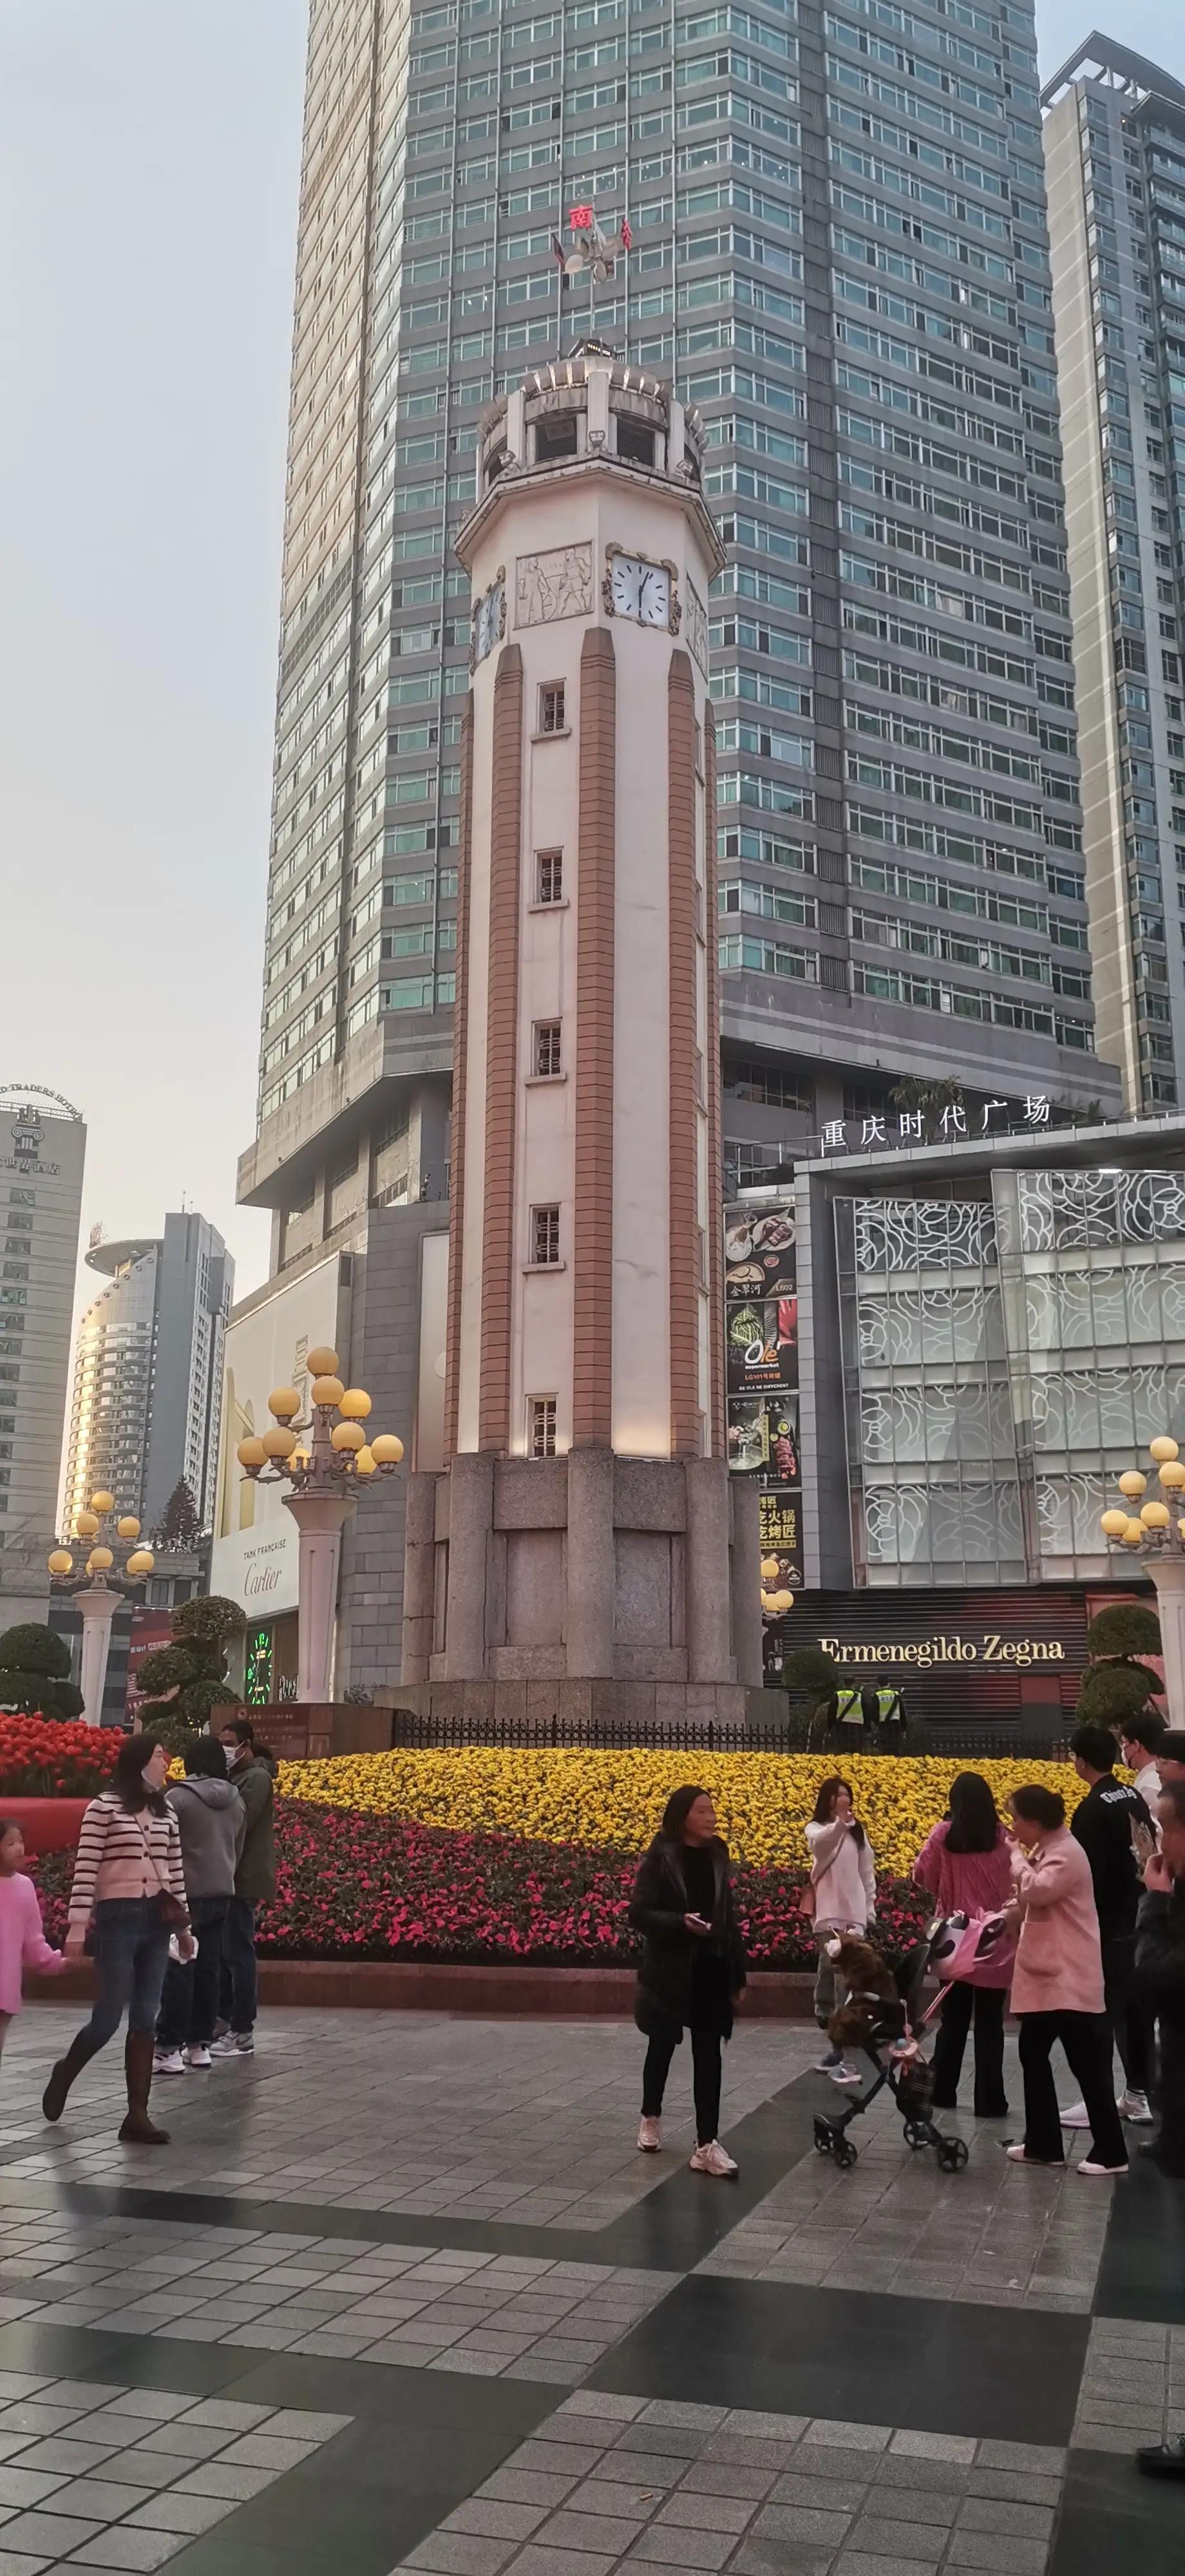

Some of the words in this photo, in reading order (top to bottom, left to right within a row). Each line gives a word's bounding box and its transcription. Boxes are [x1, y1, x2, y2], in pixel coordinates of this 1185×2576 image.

[569, 205, 593, 231] 南
[10, 1084, 55, 1097] TRADERS
[820, 1095, 1050, 1147] 重庆时代广场
[730, 1284, 761, 1297] 金翠河
[243, 1549, 256, 1560] TANK
[245, 1562, 282, 1596] Cartier
[817, 1636, 977, 1669] Ermenegildo
[983, 1634, 1065, 1667] Zegna
